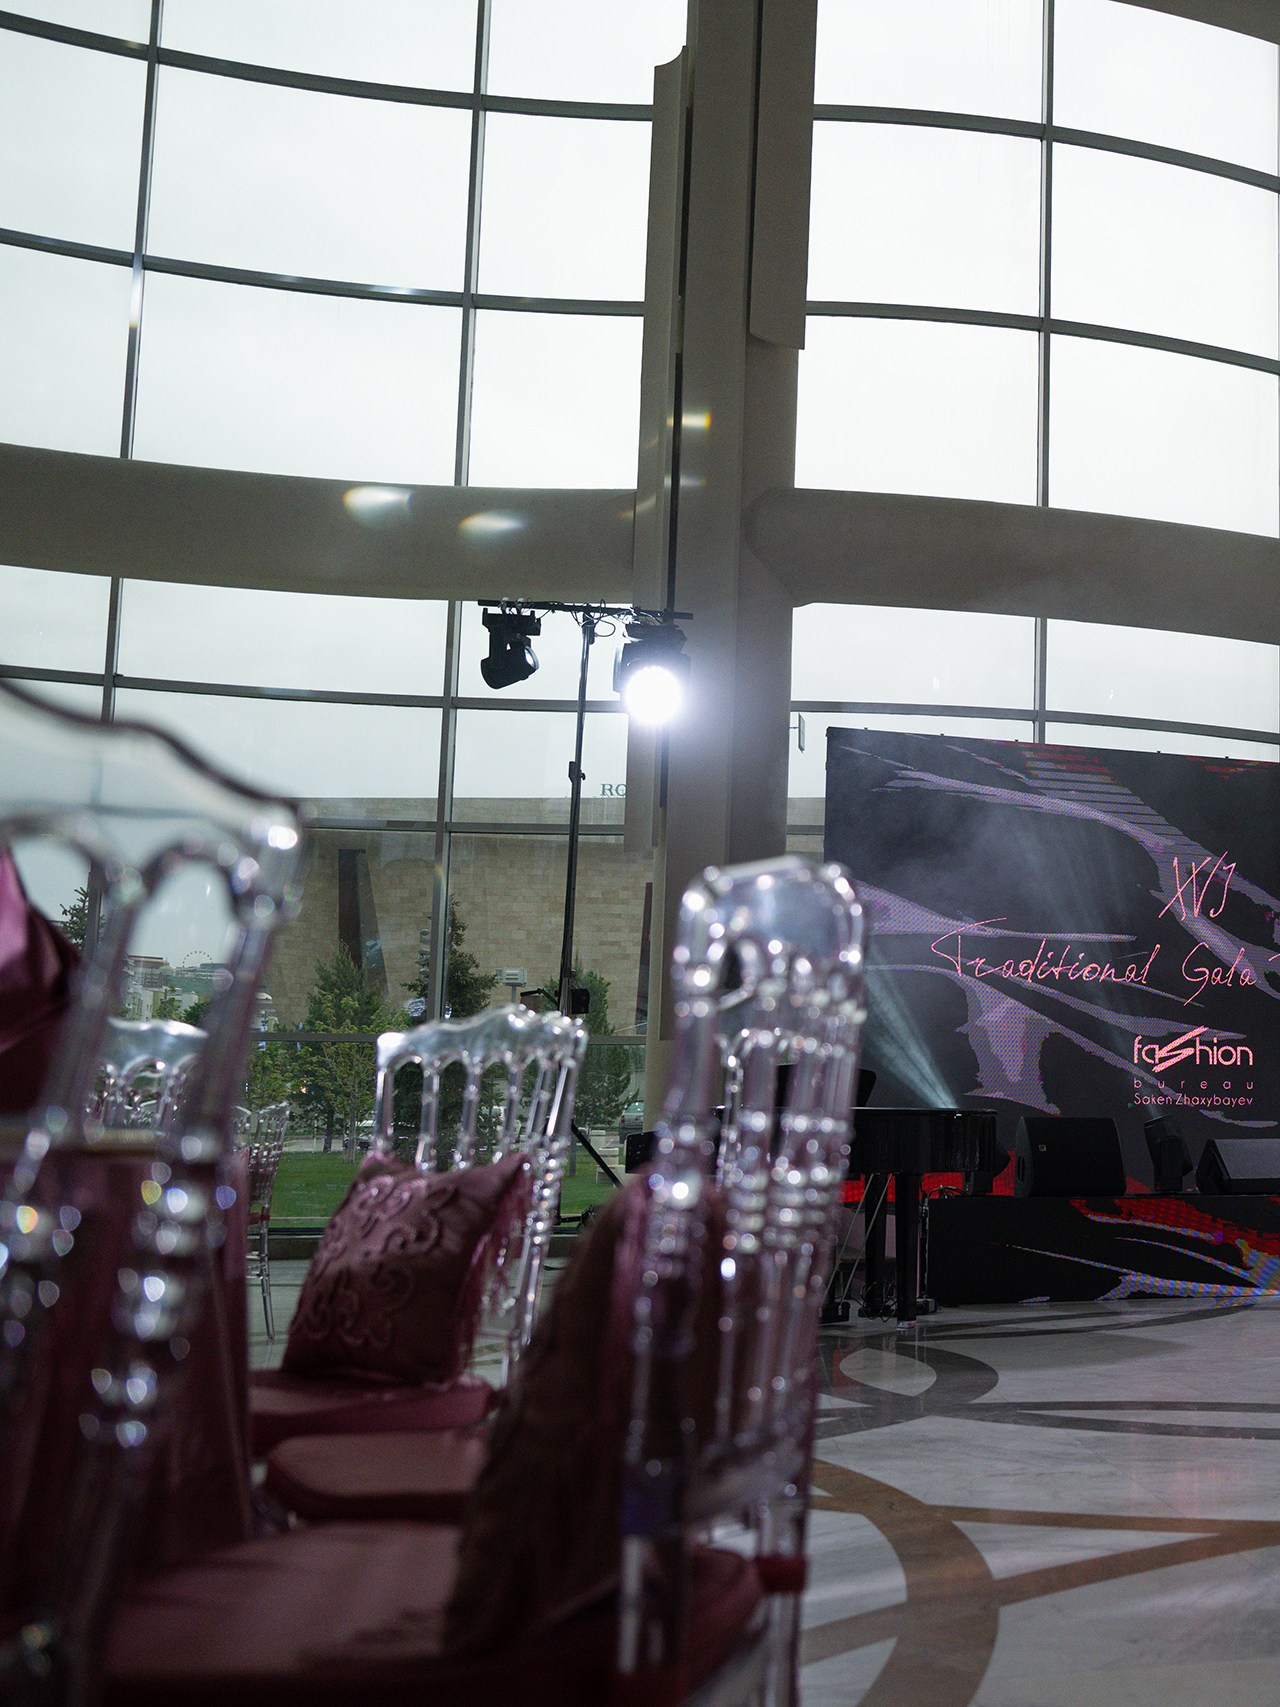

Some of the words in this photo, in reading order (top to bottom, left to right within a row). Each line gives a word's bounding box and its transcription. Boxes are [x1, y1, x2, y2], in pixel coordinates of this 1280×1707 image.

[931, 917, 1161, 984] Traditional
[1181, 941, 1258, 1007] Gala
[1133, 1025, 1254, 1073] fashion
[1133, 1092, 1173, 1106] Saken
[1175, 1092, 1254, 1108] Zhaxybayev
